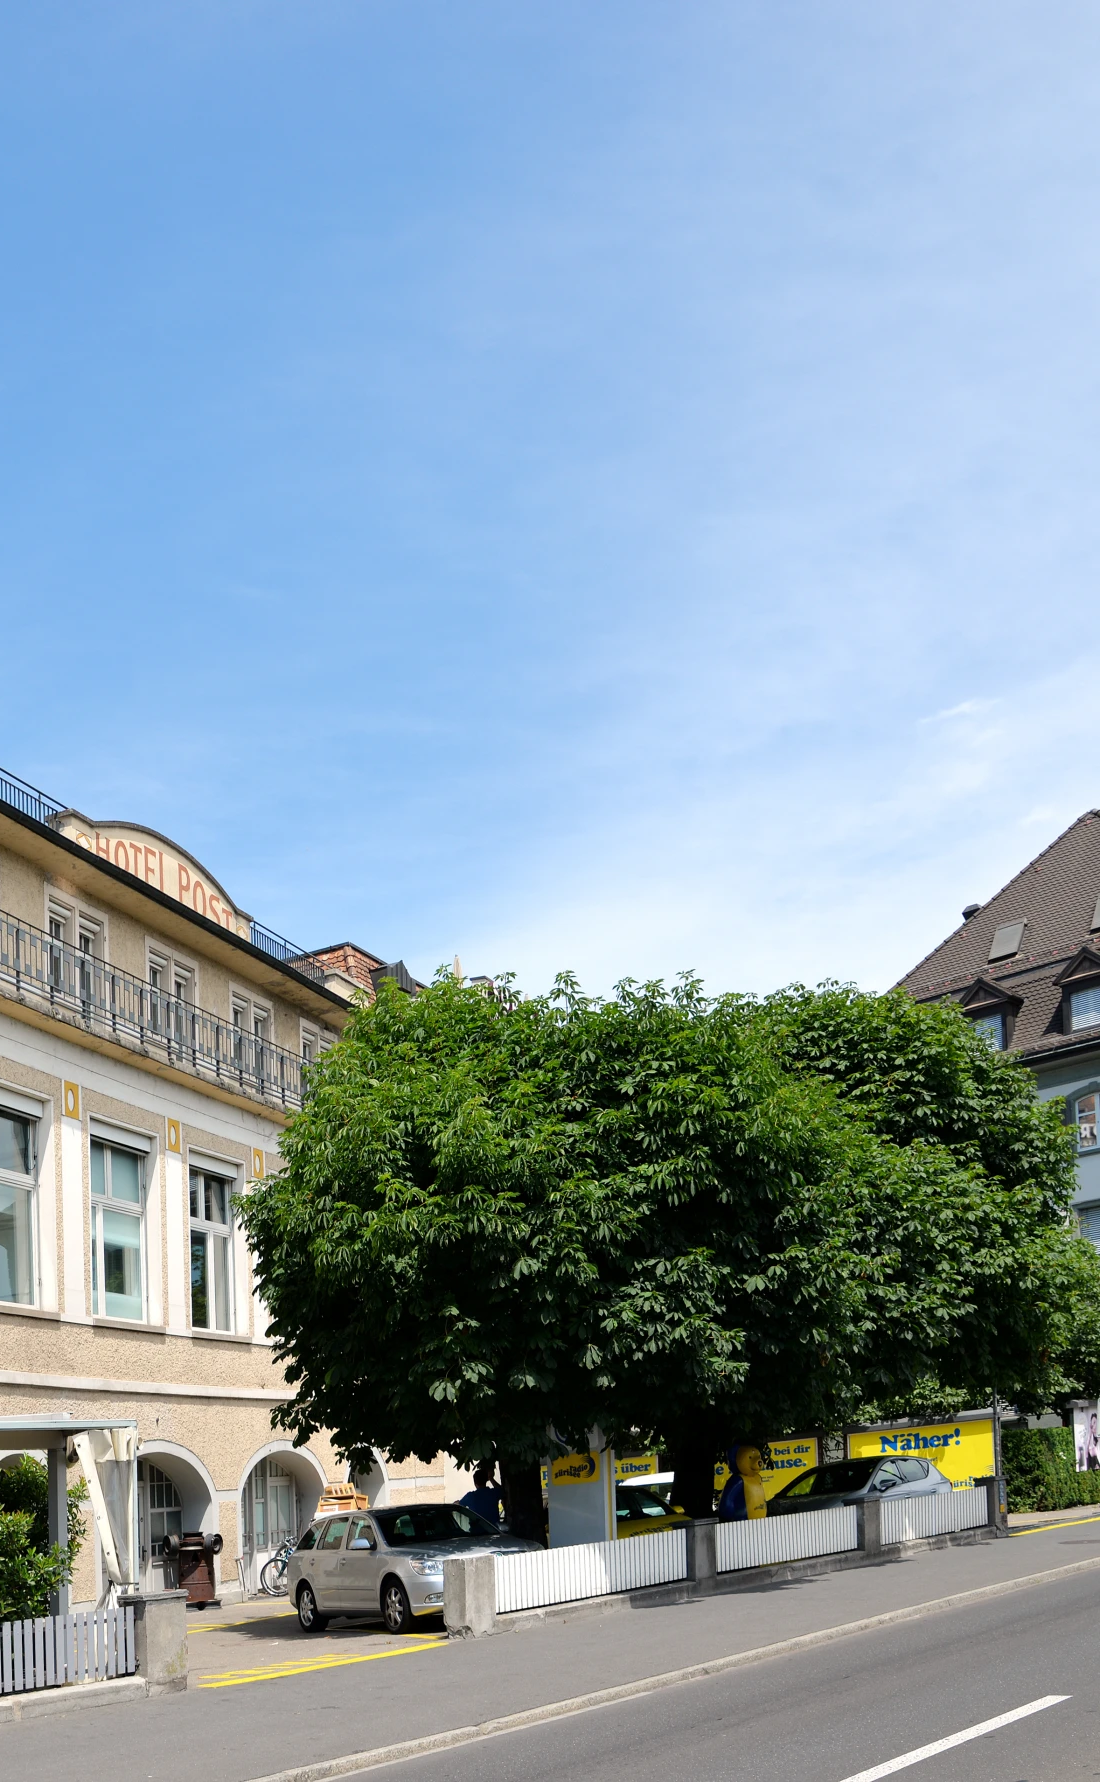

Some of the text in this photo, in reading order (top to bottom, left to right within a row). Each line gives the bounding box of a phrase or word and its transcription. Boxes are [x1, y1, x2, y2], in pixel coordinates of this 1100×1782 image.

[178, 862, 233, 931] POST
[879, 1427, 961, 1453] Näher!
[774, 1445, 811, 1456] bei dir
[569, 1464, 588, 1473] radio
[621, 1462, 651, 1474] über
